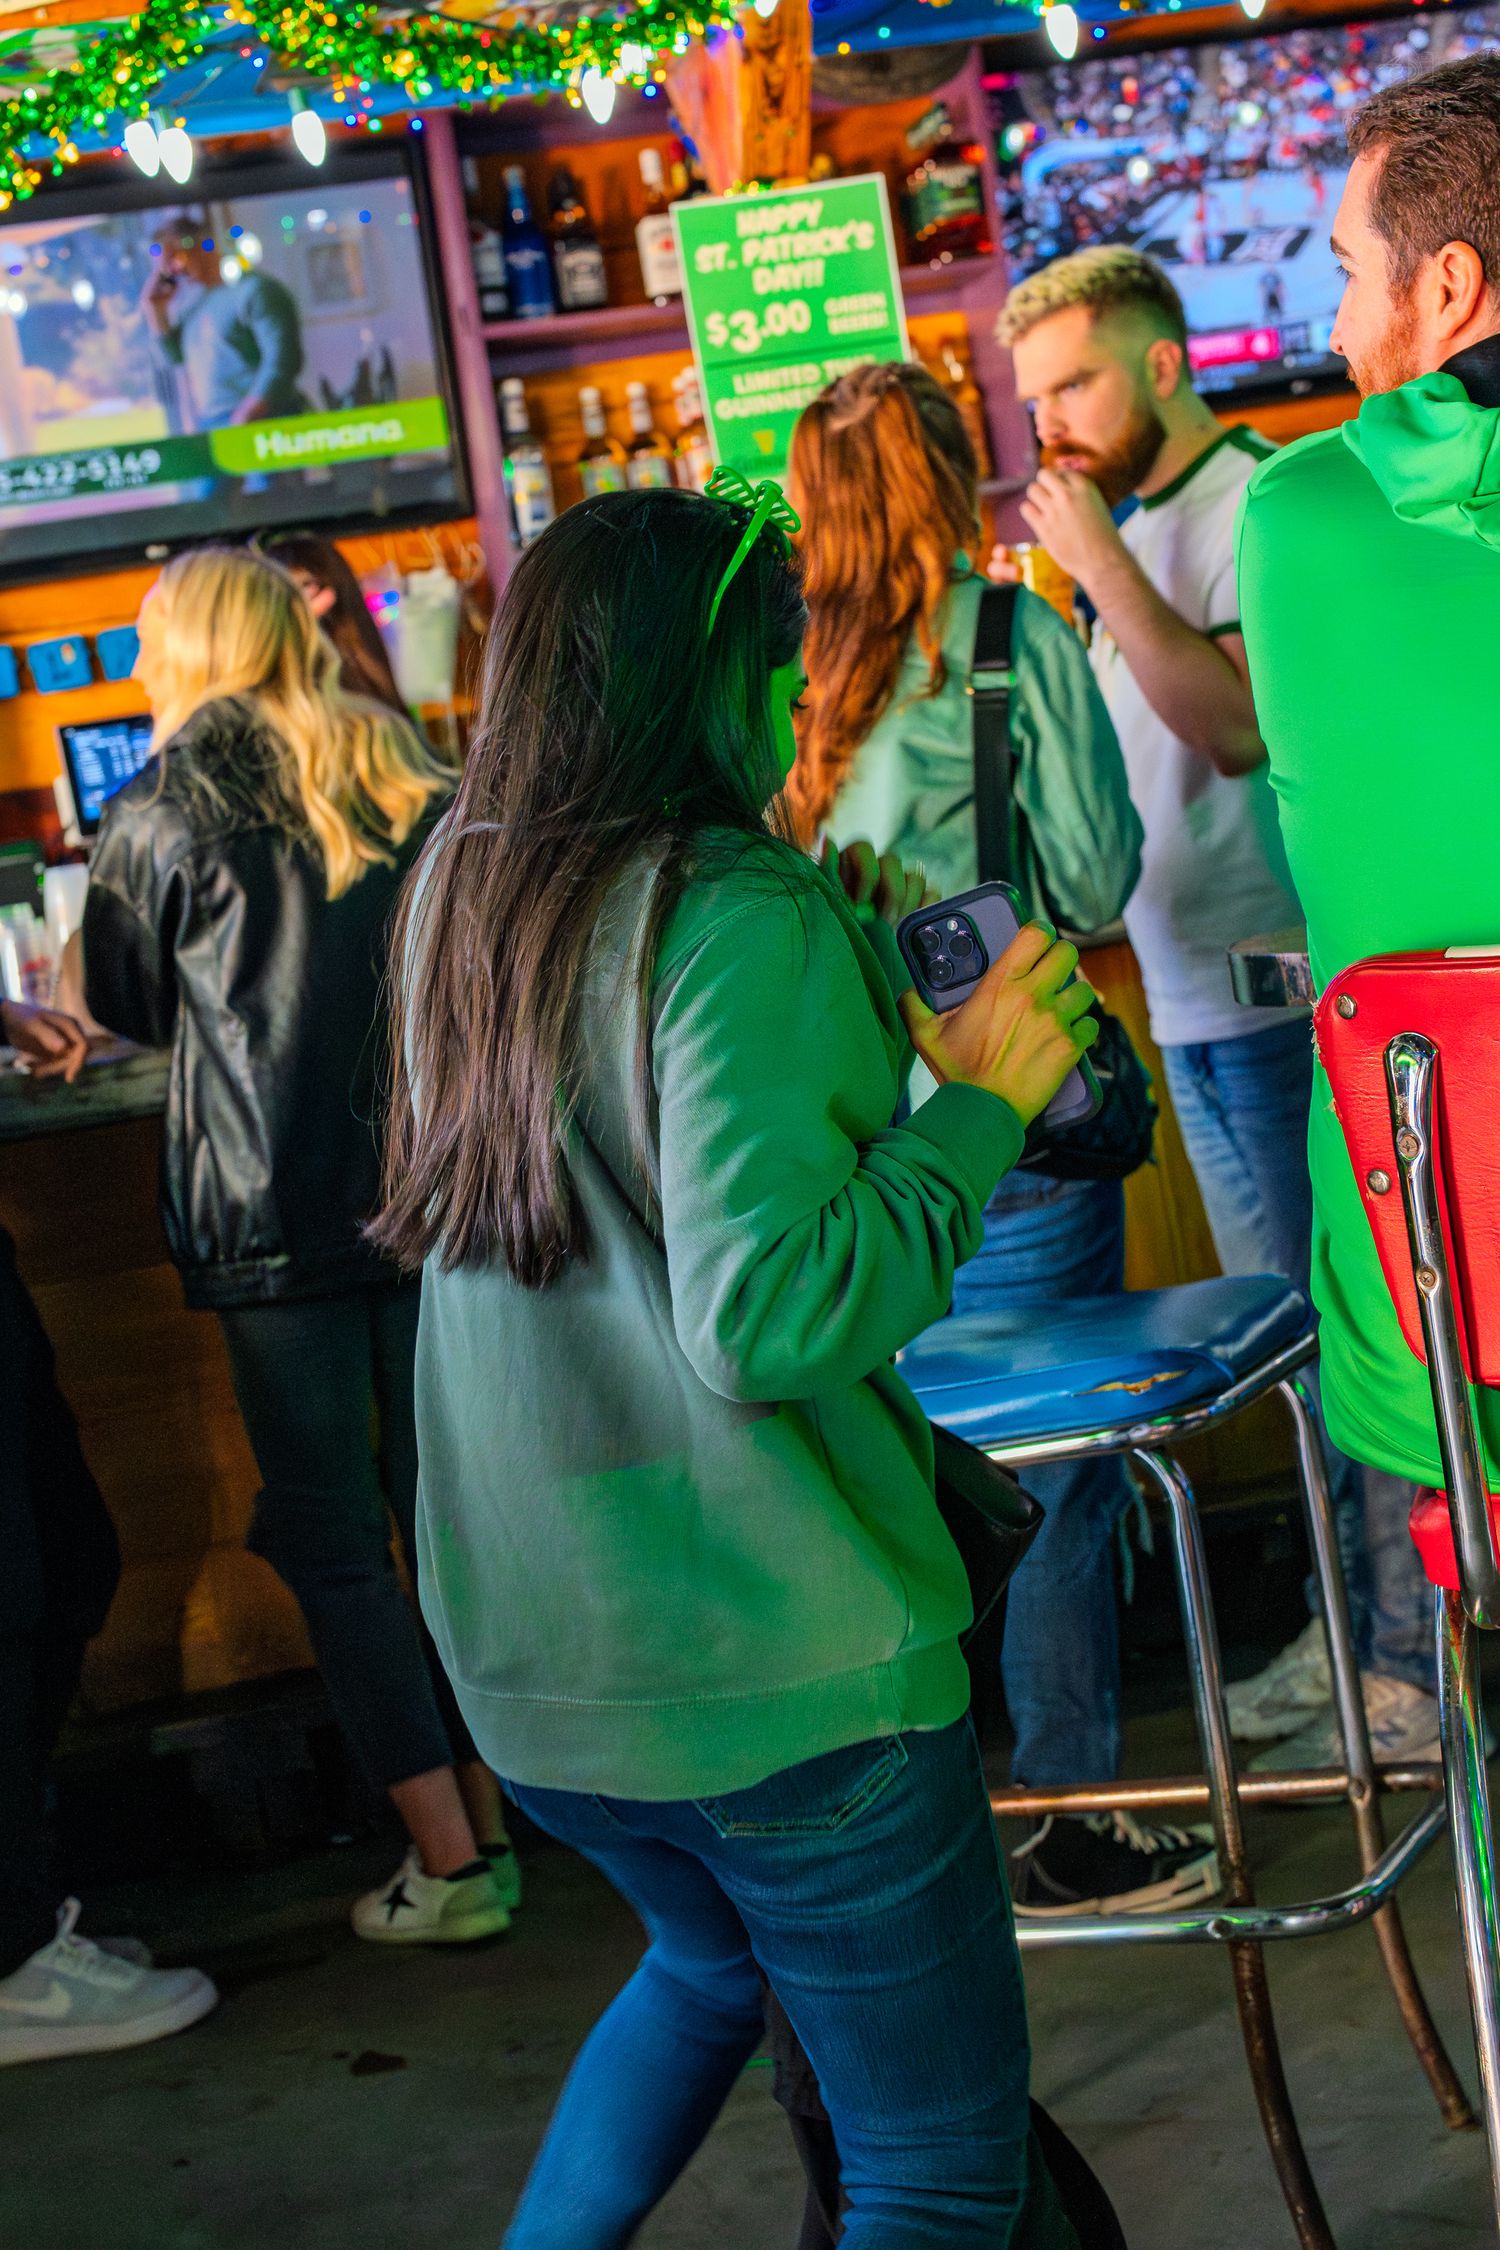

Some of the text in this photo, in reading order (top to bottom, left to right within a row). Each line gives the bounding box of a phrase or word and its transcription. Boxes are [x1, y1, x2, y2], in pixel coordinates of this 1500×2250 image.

[736, 200, 823, 237] HAPPY
[695, 243, 738, 273] ST.
[741, 221, 875, 267] PATRICK'S
[705, 300, 811, 353] $3.00
[732, 363, 821, 395] LIMITED
[255, 419, 404, 460] Humana
